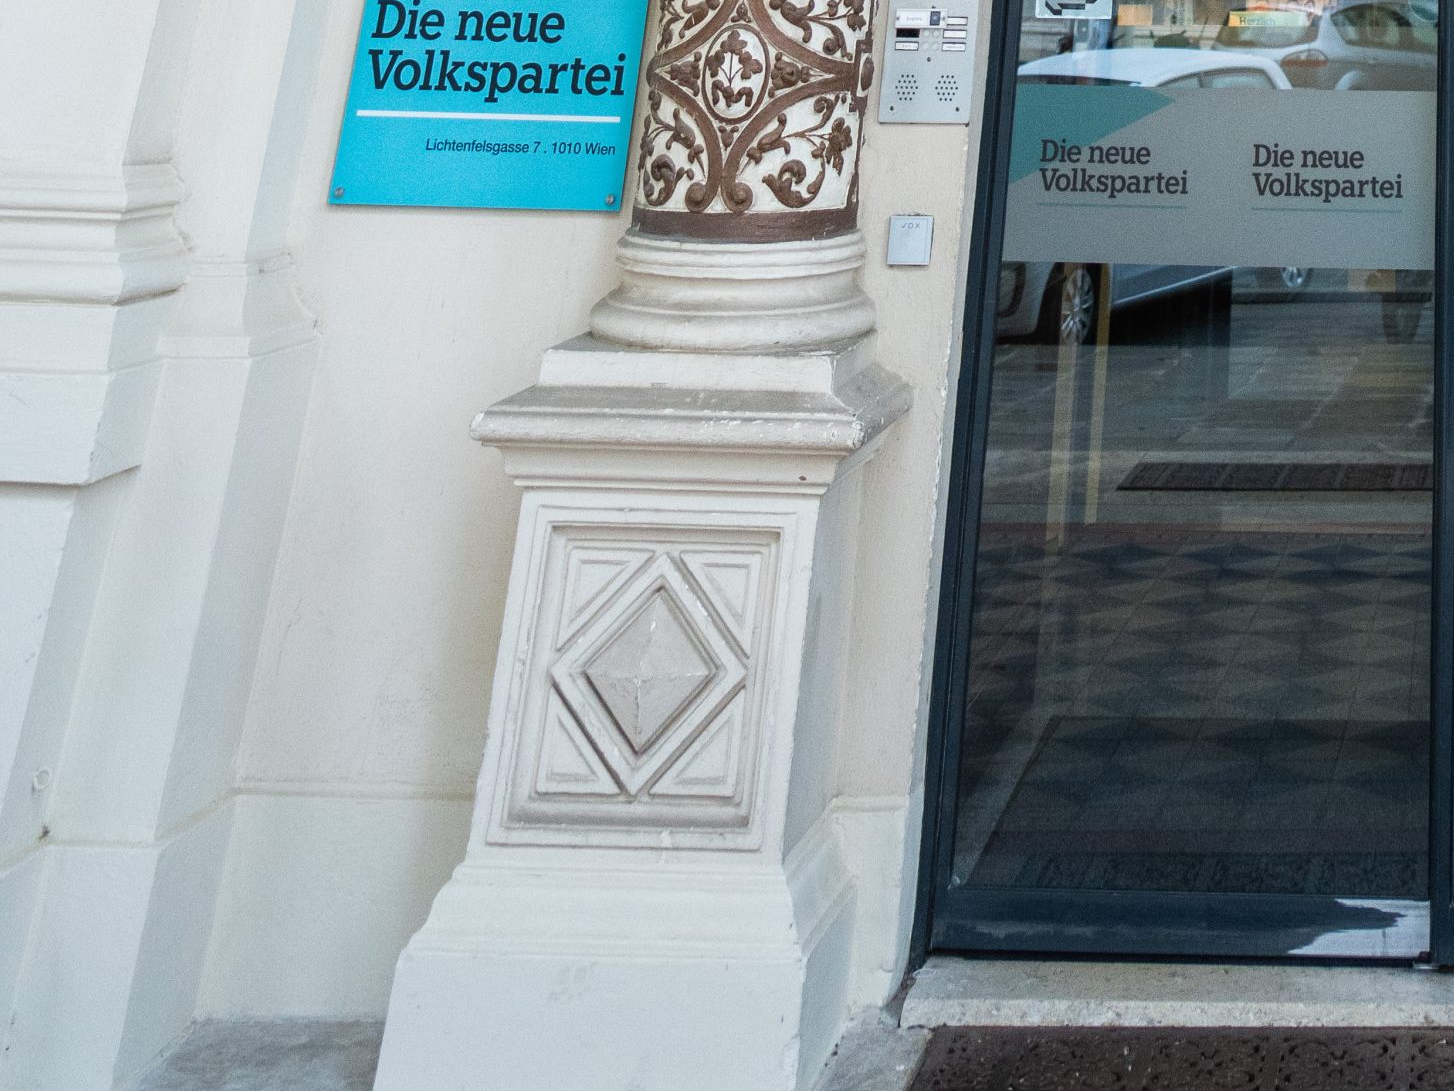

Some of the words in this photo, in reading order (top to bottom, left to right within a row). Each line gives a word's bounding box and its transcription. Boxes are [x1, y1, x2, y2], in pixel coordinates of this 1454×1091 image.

[454, 9, 565, 44] neue
[368, 49, 626, 103] Volkspartei
[425, 138, 530, 156] Lichtenfelsgasse
[533, 141, 541, 153] 7
[551, 141, 581, 154] 1010
[585, 142, 616, 155] Wien
[1039, 138, 1082, 163] Die
[1087, 145, 1151, 165] neue
[1252, 143, 1295, 168] Die
[1300, 149, 1365, 169] neue
[1039, 167, 1188, 199] Volkspartei
[1251, 172, 1404, 203] Volkspartei
